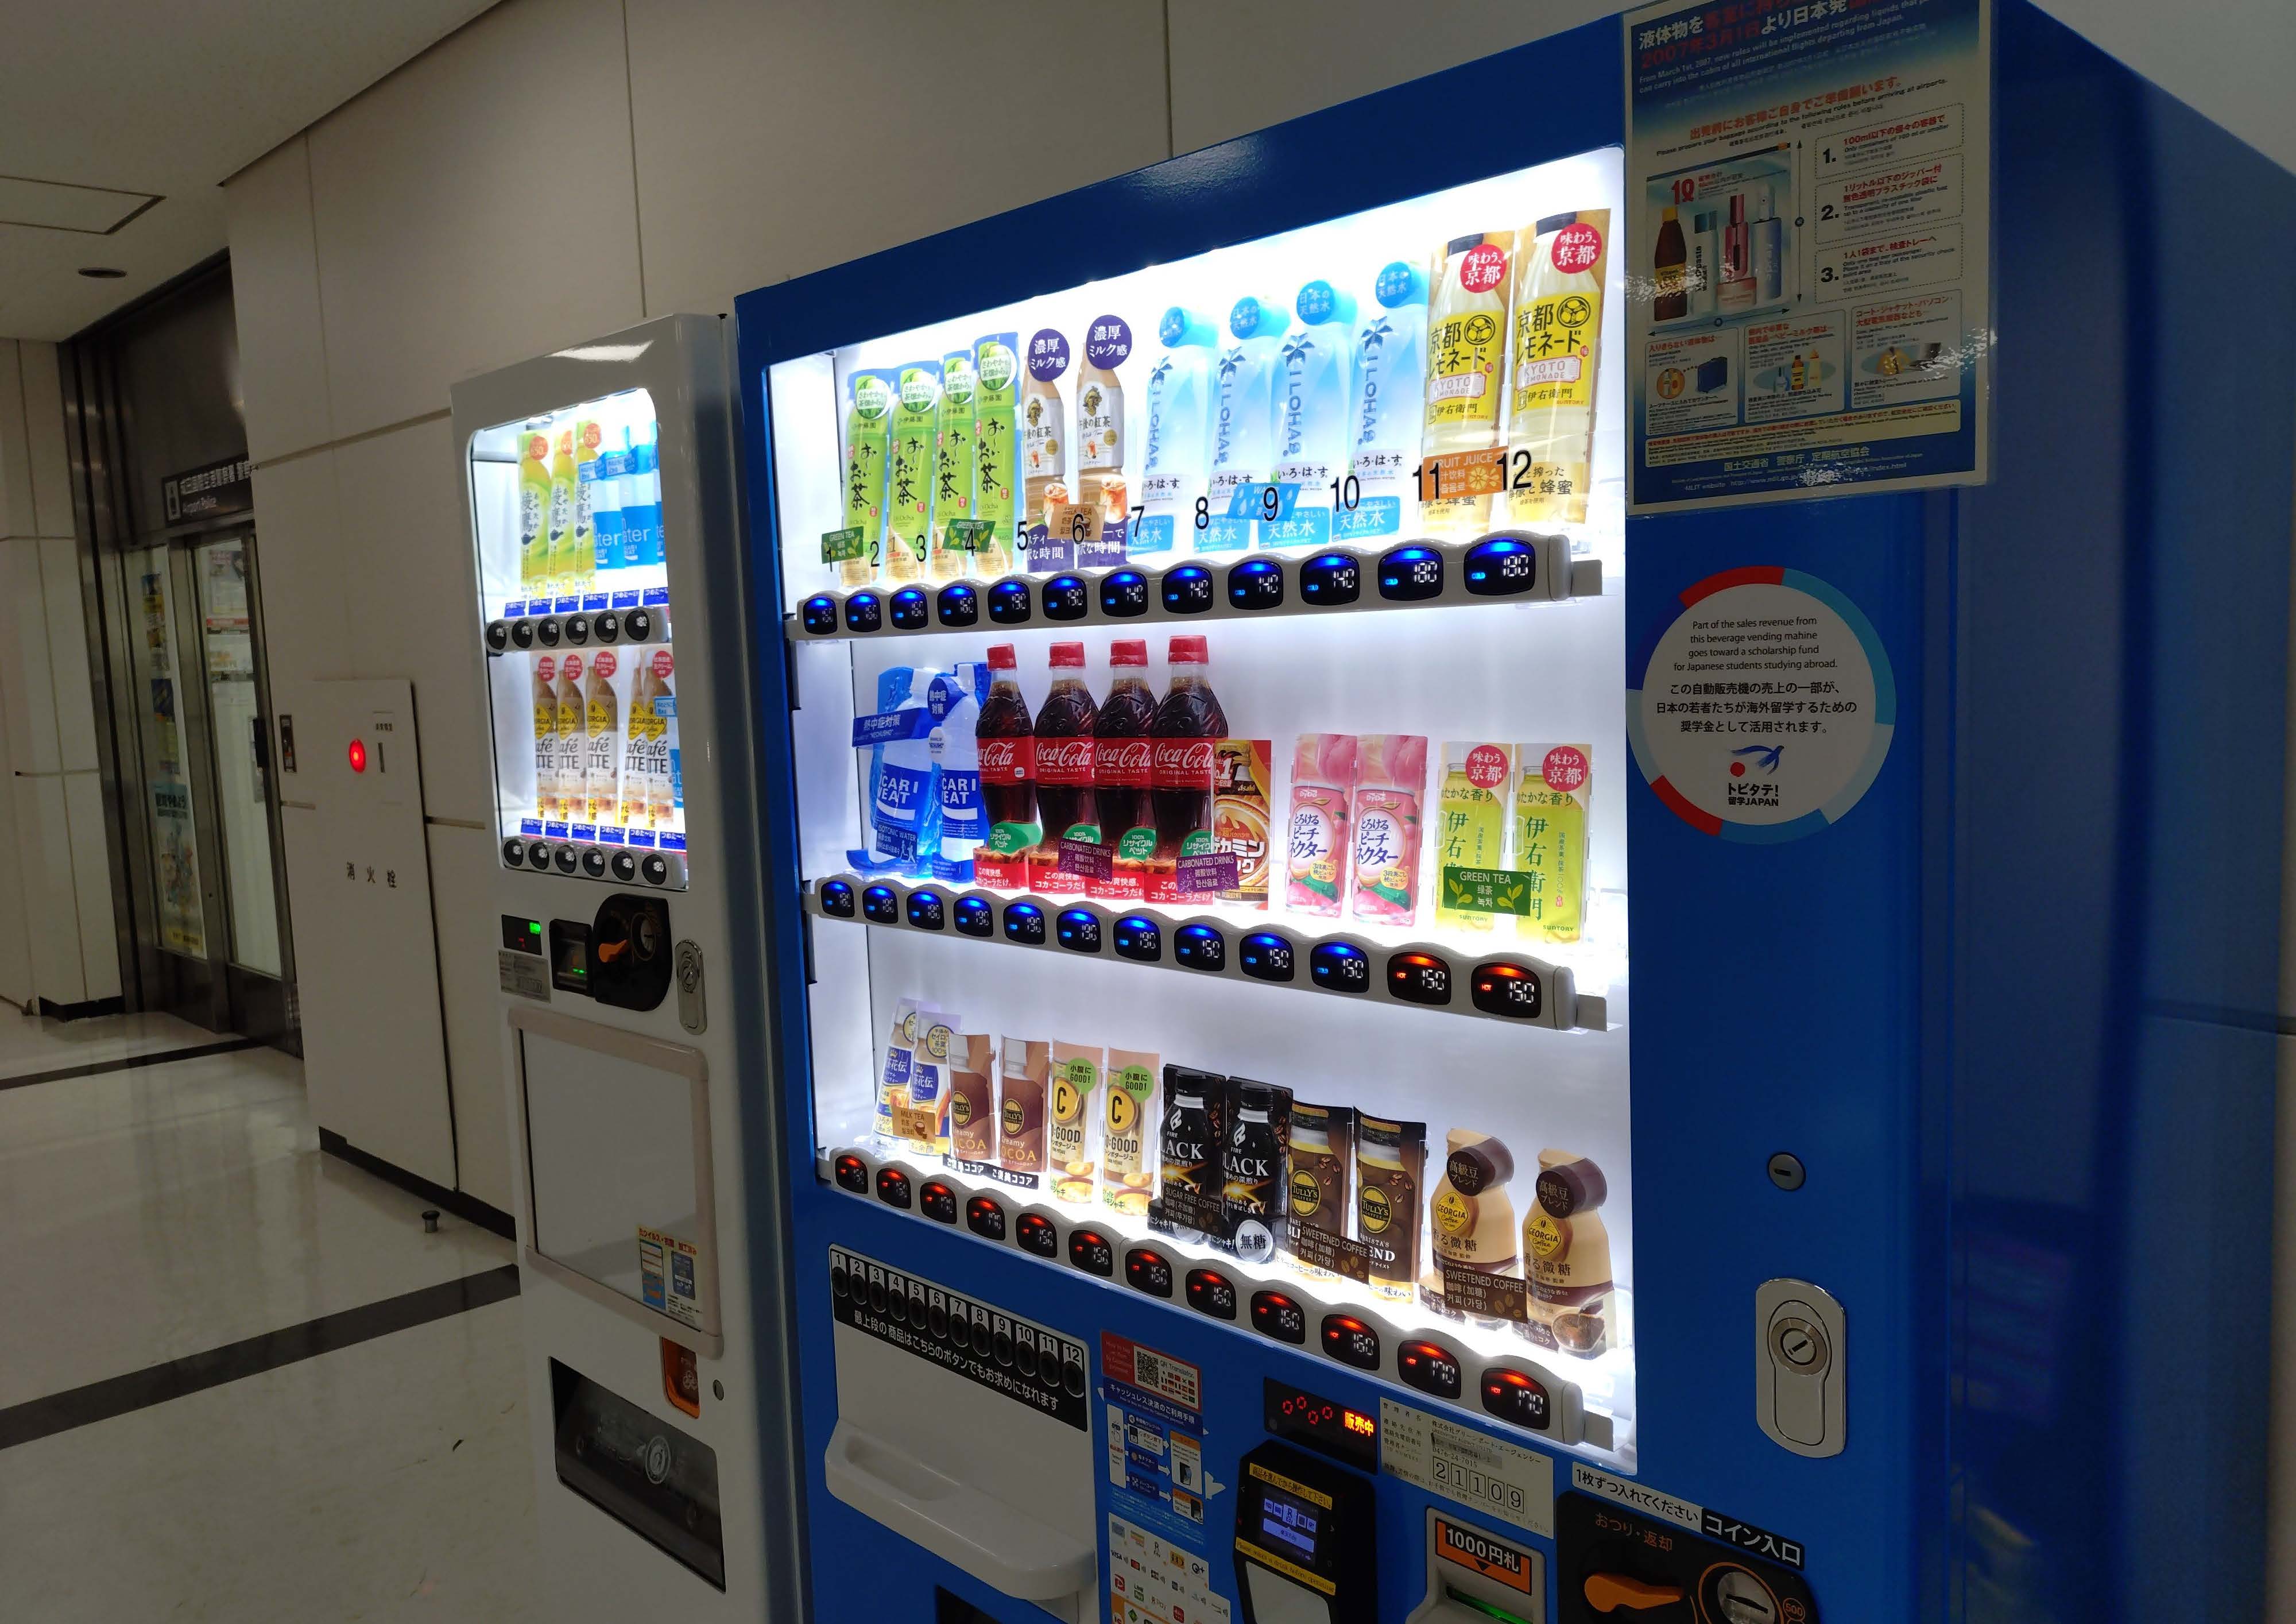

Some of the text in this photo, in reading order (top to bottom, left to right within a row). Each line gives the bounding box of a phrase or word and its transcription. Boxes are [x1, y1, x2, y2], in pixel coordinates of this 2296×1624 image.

[1823, 148, 1836, 164] 1.
[1821, 205, 1839, 221] 2.
[1557, 243, 1596, 268] 京都
[1821, 267, 1839, 283] 3.
[1517, 304, 1555, 334] 京都
[1094, 324, 1121, 341] 濃厚
[1089, 344, 1128, 358] ミルク感
[1463, 450, 1494, 465] JUICE
[1495, 449, 1532, 490] 12
[1412, 461, 1440, 502] 11
[1330, 475, 1360, 512] 10
[1263, 487, 1279, 521] 9
[1195, 497, 1209, 529] 8
[1340, 510, 1385, 531] 天然水
[1072, 514, 1085, 544] 6
[1131, 505, 1144, 538] 7
[965, 528, 975, 556] 4
[1017, 521, 1028, 550] 5
[870, 541, 880, 567] 2
[916, 534, 926, 562] 3
[1259, 575, 1278, 593] 140
[1333, 569, 1354, 588] 140
[1693, 617, 1817, 630] Part of the sales revenue from
[1691, 631, 1818, 644] this beverage vending mahine
[1689, 649, 1708, 659] goes
[1710, 647, 1739, 656] toward
[1748, 645, 1797, 656] scholarship
[1798, 645, 1819, 654] fund
[1674, 659, 1838, 672] for Japanese students studying abroad.
[1670, 681, 1841, 695] この自動販売機の売上の一部が、
[1657, 701, 1857, 714] 日本の若者たちが海外留学するための
[1681, 721, 1827, 734] 奨学金として活用されます。
[1550, 754, 1579, 765] 味わう
[1548, 766, 1582, 784] 京都
[1728, 783, 1779, 796] トビタテ!
[1728, 796, 1779, 807] 留学JAPAN
[1361, 818, 1389, 830] とろける
[1361, 833, 1389, 846] ピーチ
[1178, 855, 1235, 869] CARBONATED DRINKS
[1357, 846, 1398, 865] ネクター
[1460, 871, 1512, 884] GREEN TEA
[1269, 948, 1289, 968] 150
[1343, 958, 1364, 979] 150
[1423, 969, 1445, 991] 150
[1482, 981, 1535, 1003] HOT 150
[1070, 1073, 1091, 1084] GOOD!
[1437, 1204, 1466, 1220] GEORGIA
[1240, 1234, 1267, 1250] 無糖
[836, 1254, 841, 1265] 1
[854, 1260, 861, 1272] 2
[873, 1268, 880, 1280] 3
[893, 1275, 899, 1287] 4
[1446, 1269, 1523, 1293] SWEETENED COFFEE
[913, 1283, 919, 1296] 5
[934, 1292, 940, 1304] 6
[955, 1300, 961, 1312] 7
[977, 1309, 984, 1321] 8
[998, 1318, 1005, 1331] 9
[1019, 1327, 1032, 1342] 10
[1042, 1336, 1055, 1351] 11
[854, 1310, 1059, 1410] 最上段の商品はこちらのボタンでもお求めになれます
[1066, 1345, 1080, 1362] 12
[1345, 1412, 1374, 1437] 販売中
[1576, 1468, 1698, 1522] 1枚ずつ入れてください
[1594, 1511, 1673, 1552] おつり・返却
[1704, 1513, 1802, 1566] コイン入口
[1446, 1527, 1520, 1573] 1000円札
